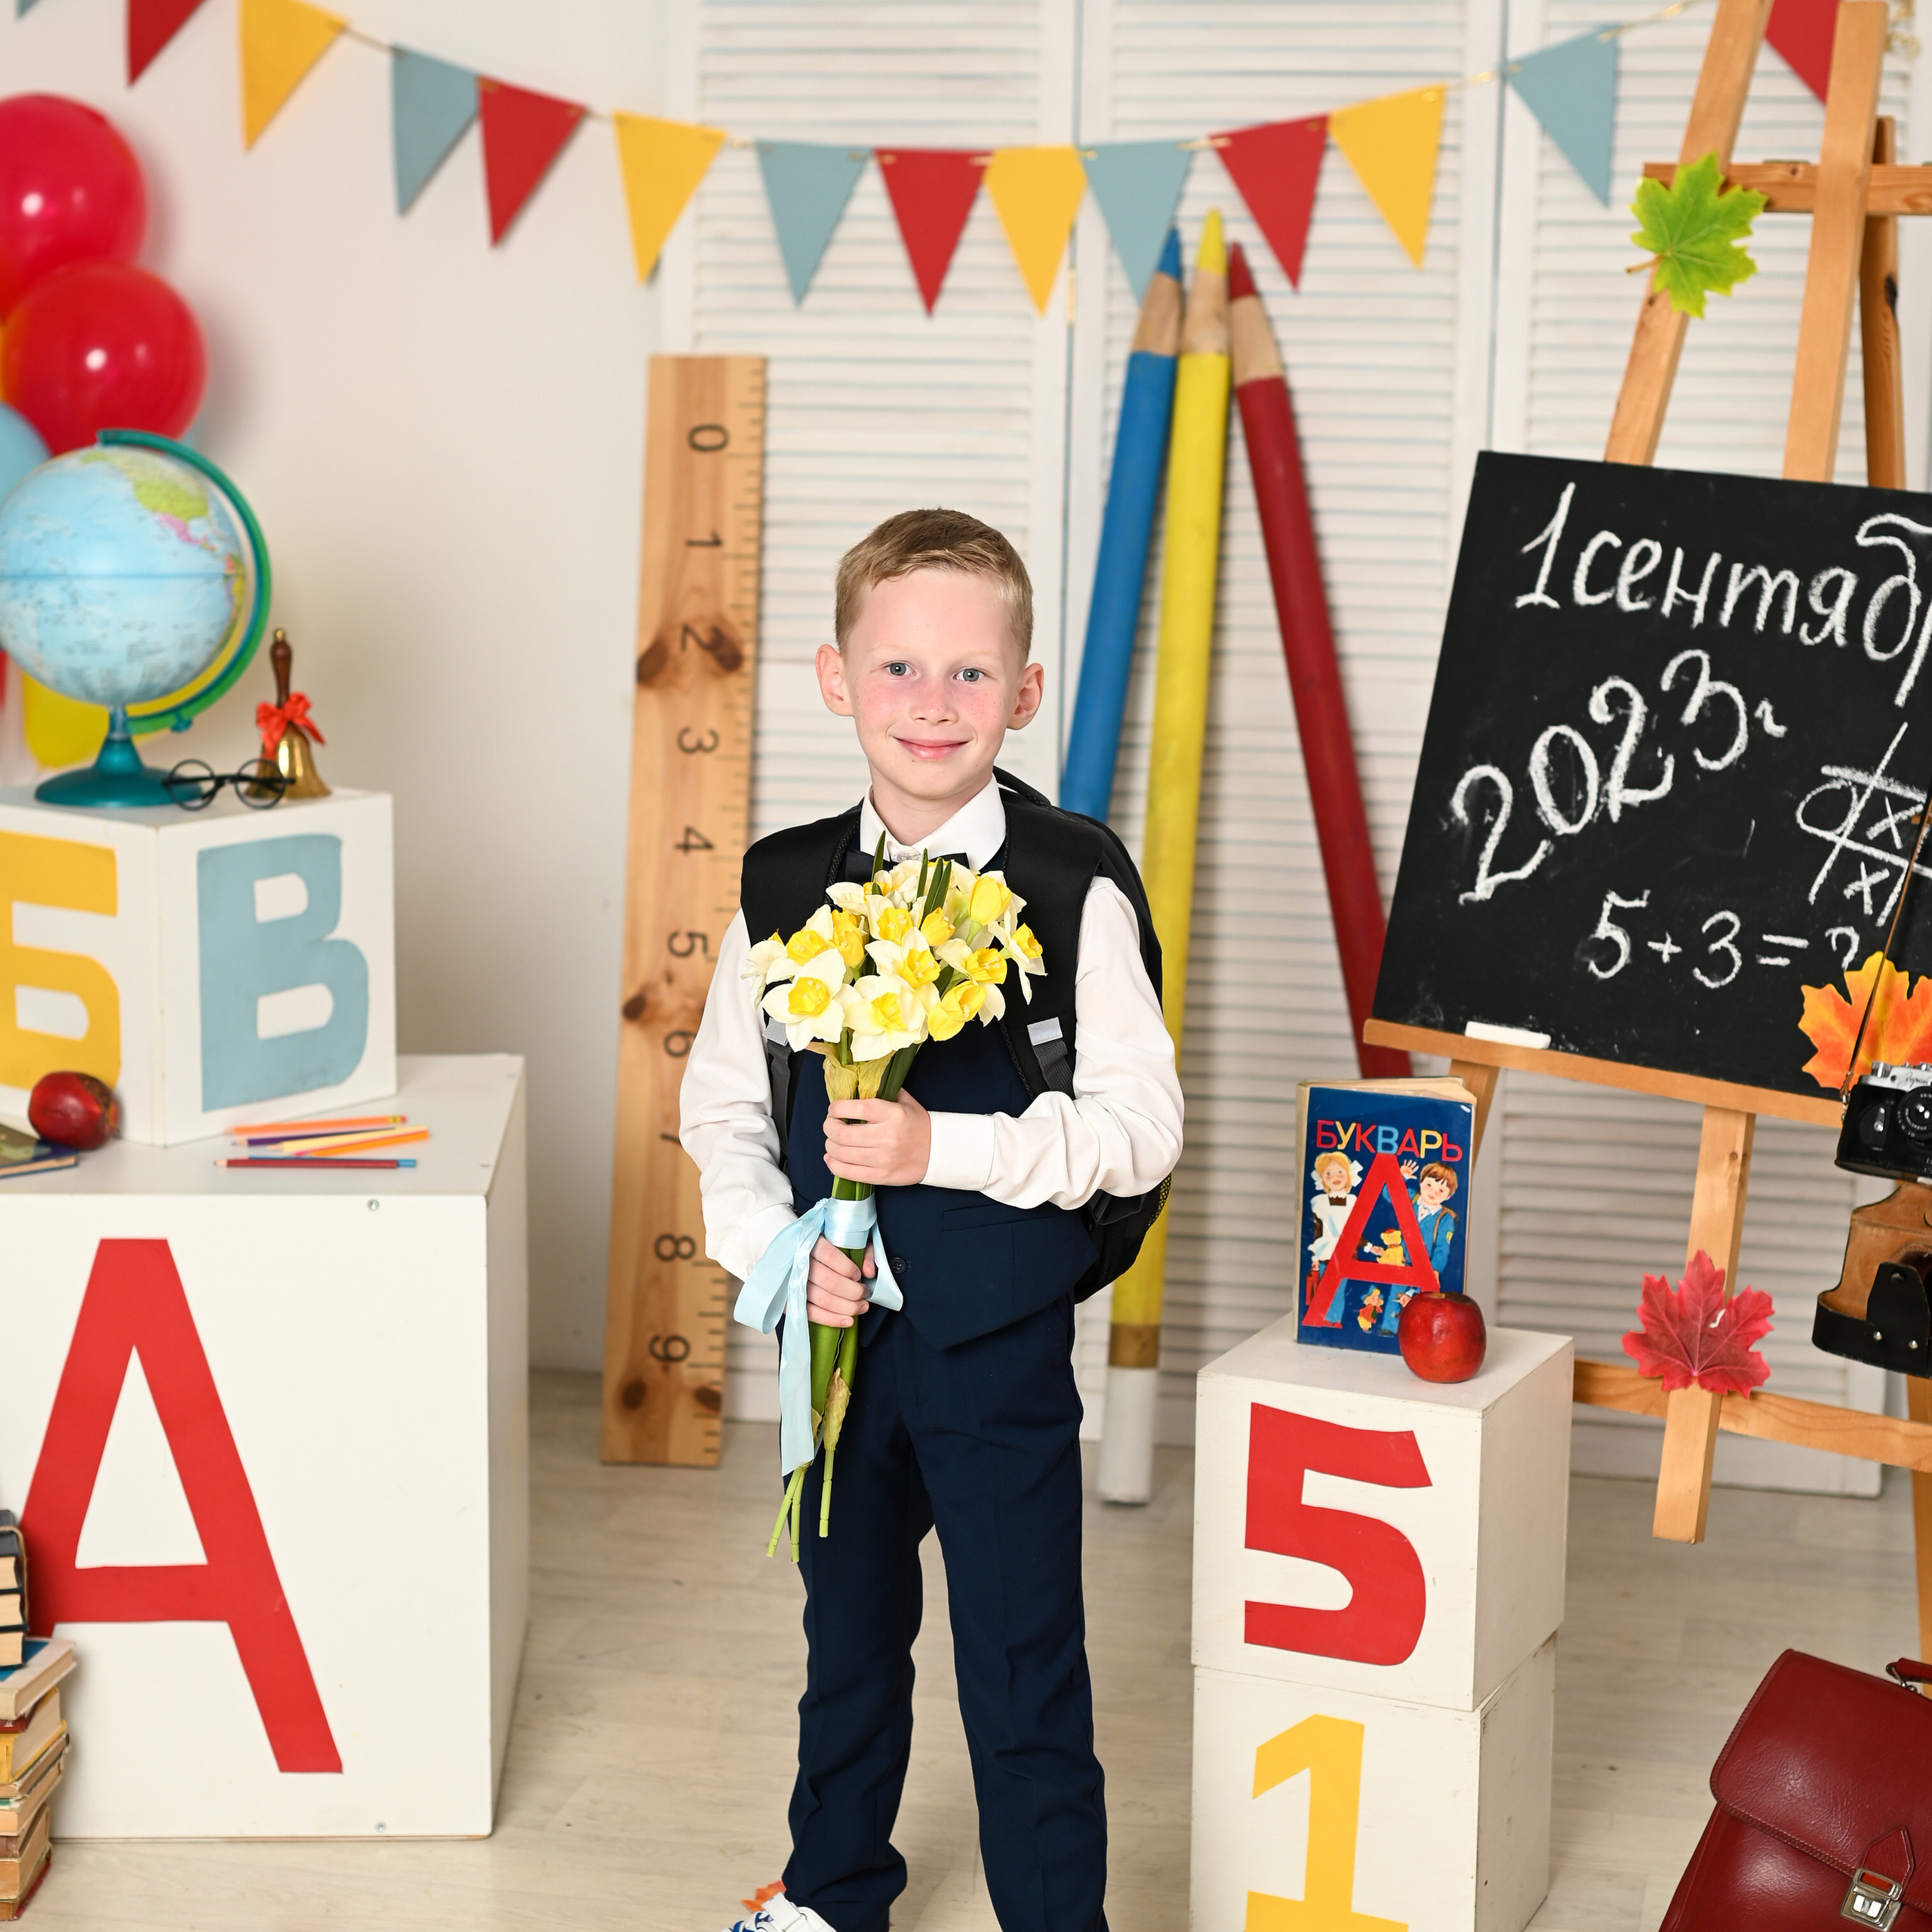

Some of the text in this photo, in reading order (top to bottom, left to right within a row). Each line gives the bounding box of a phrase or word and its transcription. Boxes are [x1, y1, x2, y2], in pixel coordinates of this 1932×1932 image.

[685, 531, 724, 548] 1
[681, 624, 722, 654] 2
[677, 727, 719, 755] 3
[675, 826, 715, 855] 4
[667, 930, 708, 958] 5
[1316, 1119, 1463, 1162] БУКВАРЬ
[654, 1233, 697, 1263] 8
[648, 1334, 691, 1366] 9
[1244, 1402, 1432, 1667] 5
[1245, 1714, 1409, 1932] 1
